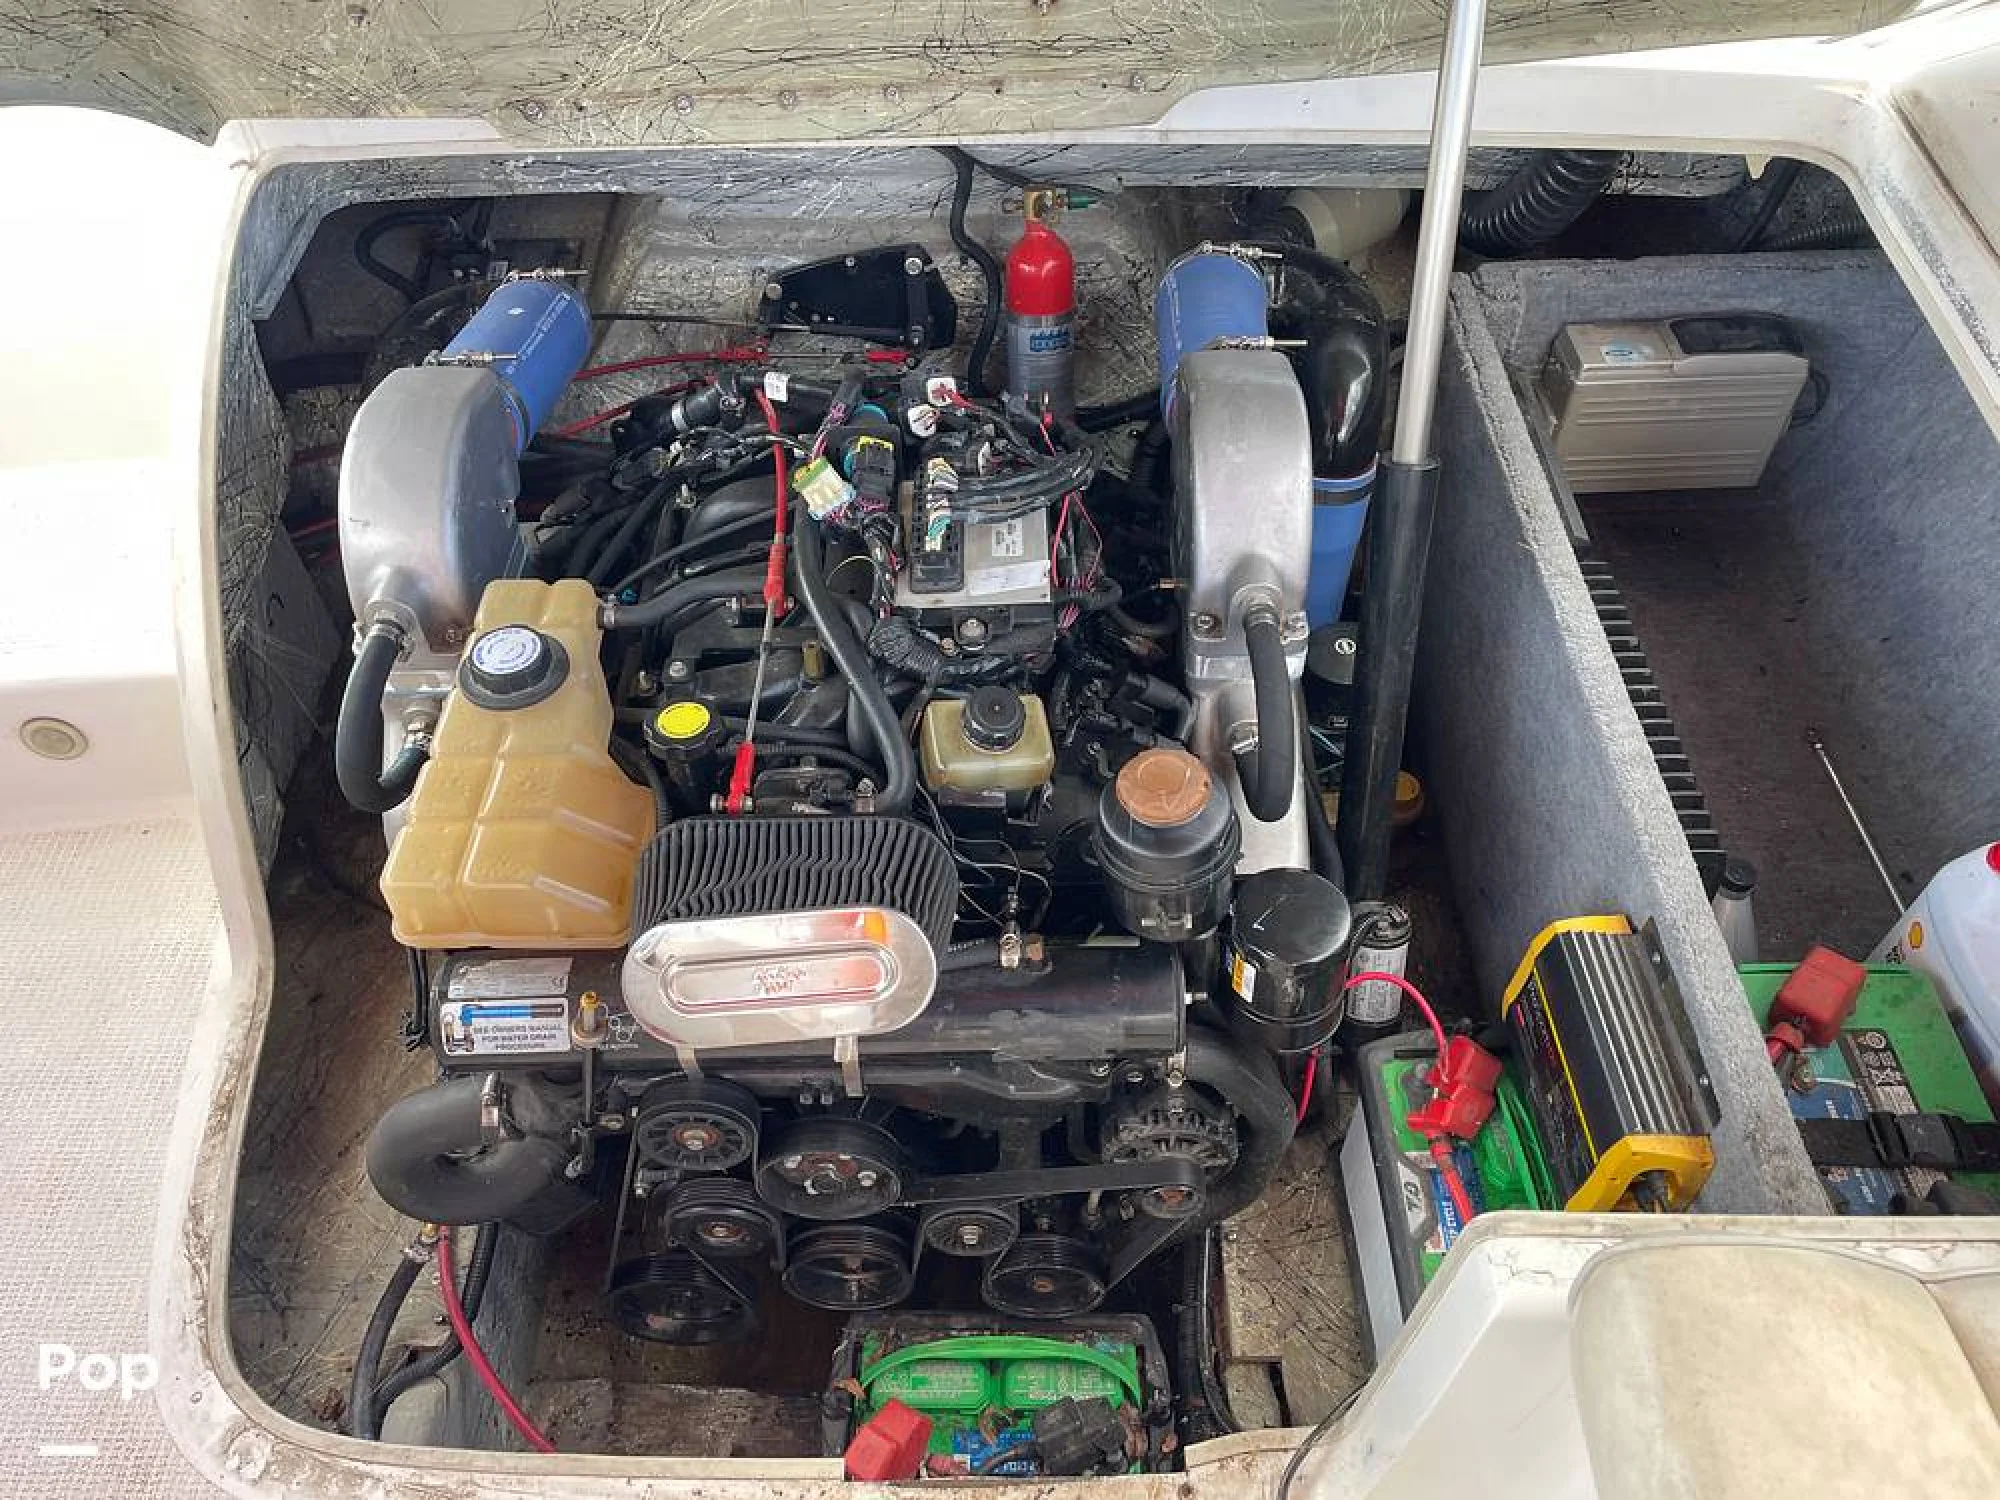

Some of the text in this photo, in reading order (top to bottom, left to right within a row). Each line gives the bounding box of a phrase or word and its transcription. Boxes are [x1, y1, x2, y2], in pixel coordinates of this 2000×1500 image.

[492, 1025, 527, 1033] OWNERS
[528, 1023, 563, 1032] MANUAL
[502, 1033, 528, 1041] WATER
[530, 1032, 557, 1040] DRAIN
[496, 1043, 545, 1051] PROCEDURE
